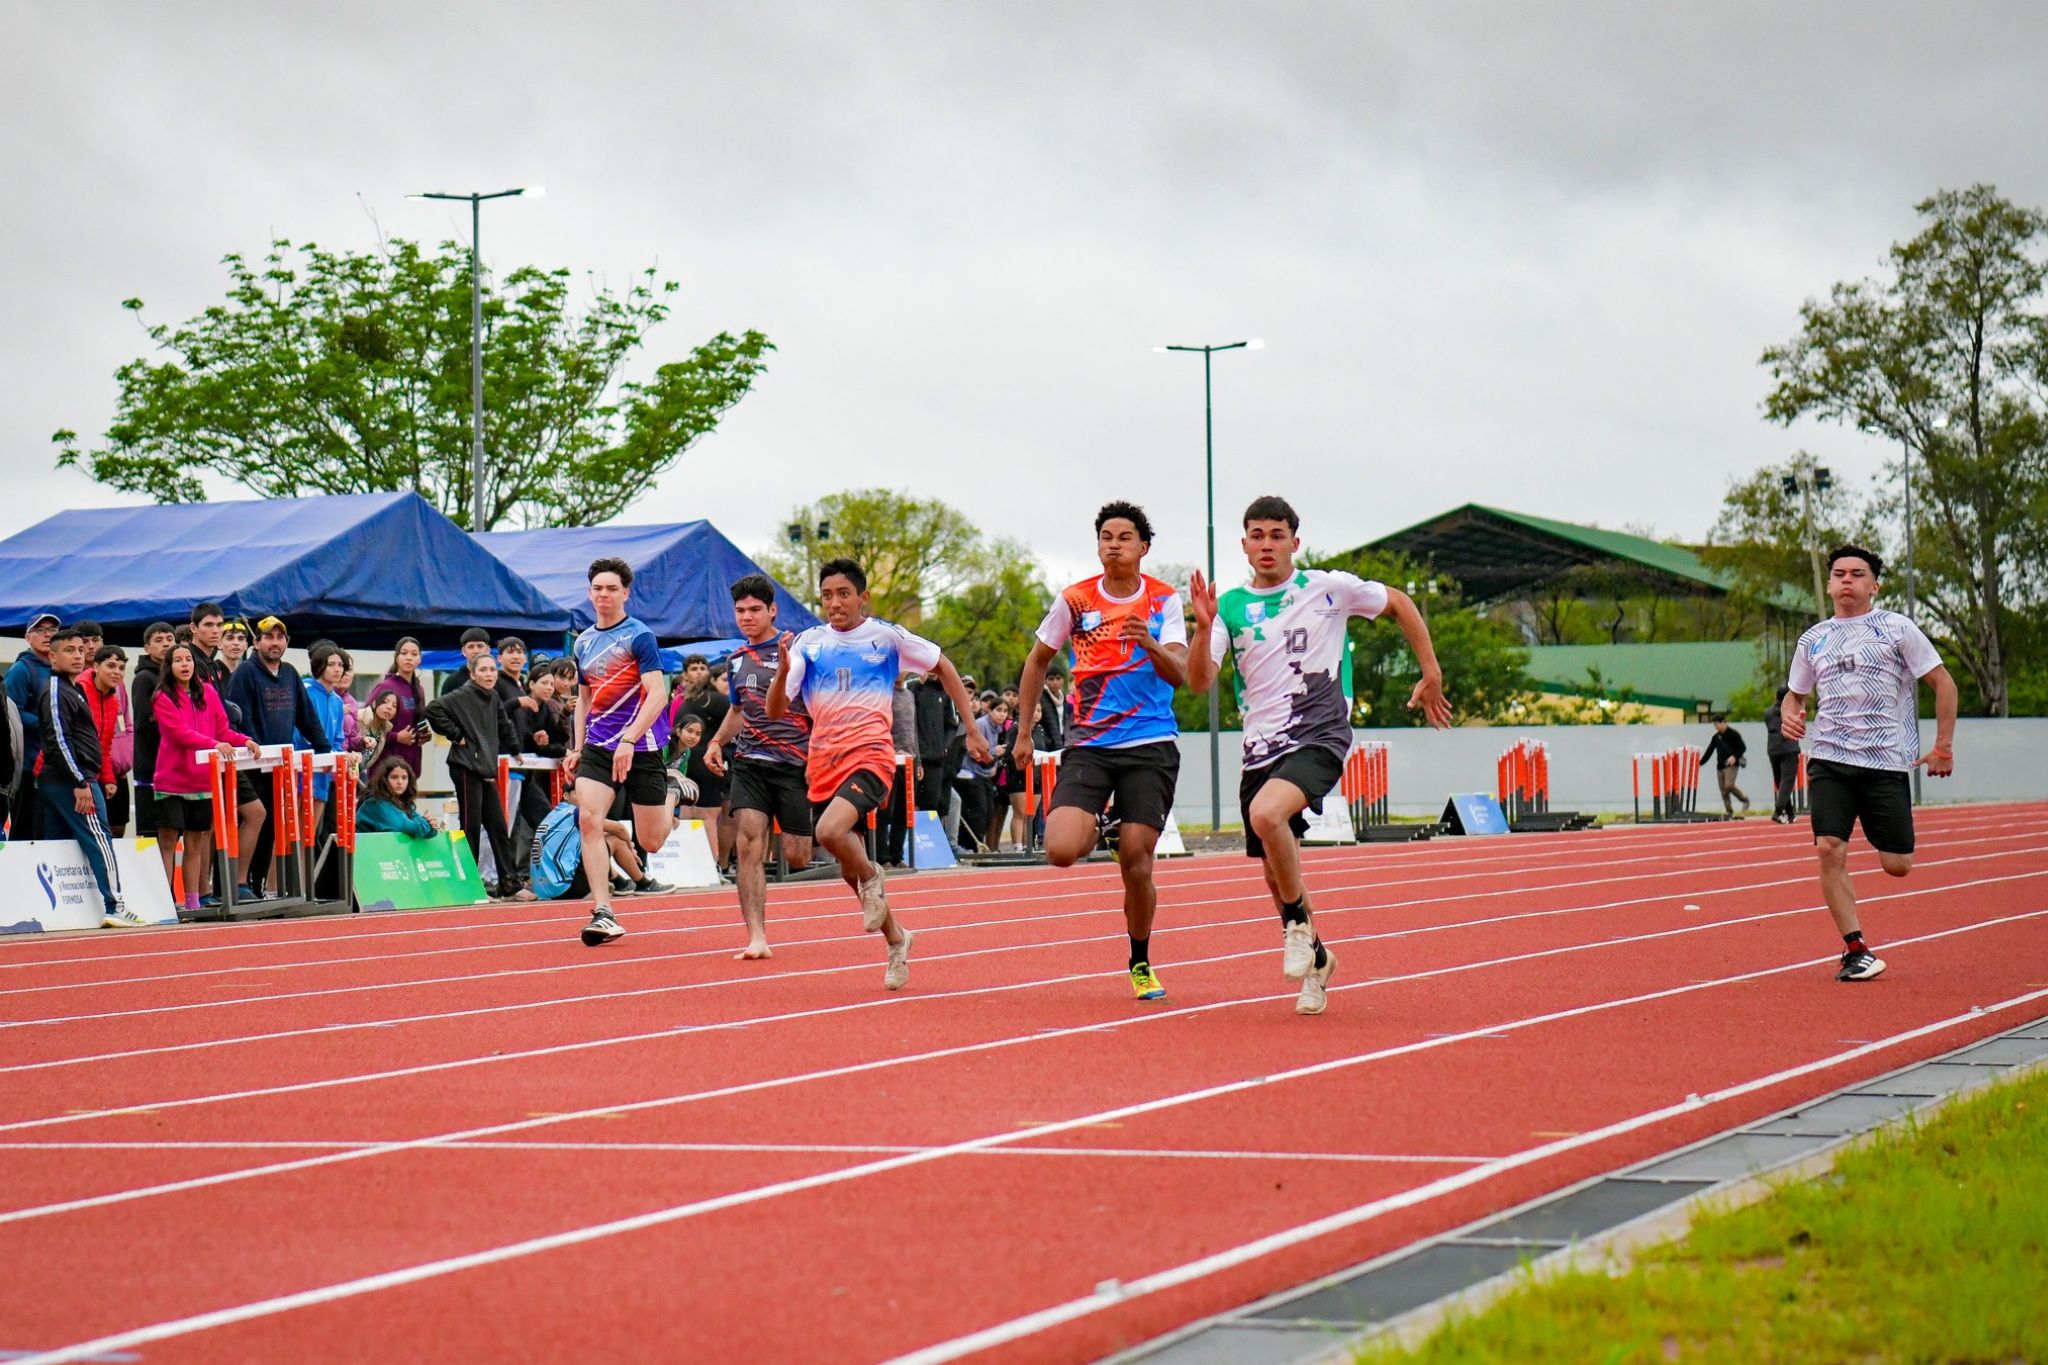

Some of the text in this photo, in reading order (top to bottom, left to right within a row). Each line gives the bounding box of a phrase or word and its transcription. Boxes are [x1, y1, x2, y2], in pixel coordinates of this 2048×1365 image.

[1283, 627, 1307, 653] 10
[1836, 653, 1855, 674] 10
[835, 667, 851, 691] 11
[62, 895, 84, 904] FORMOSA
